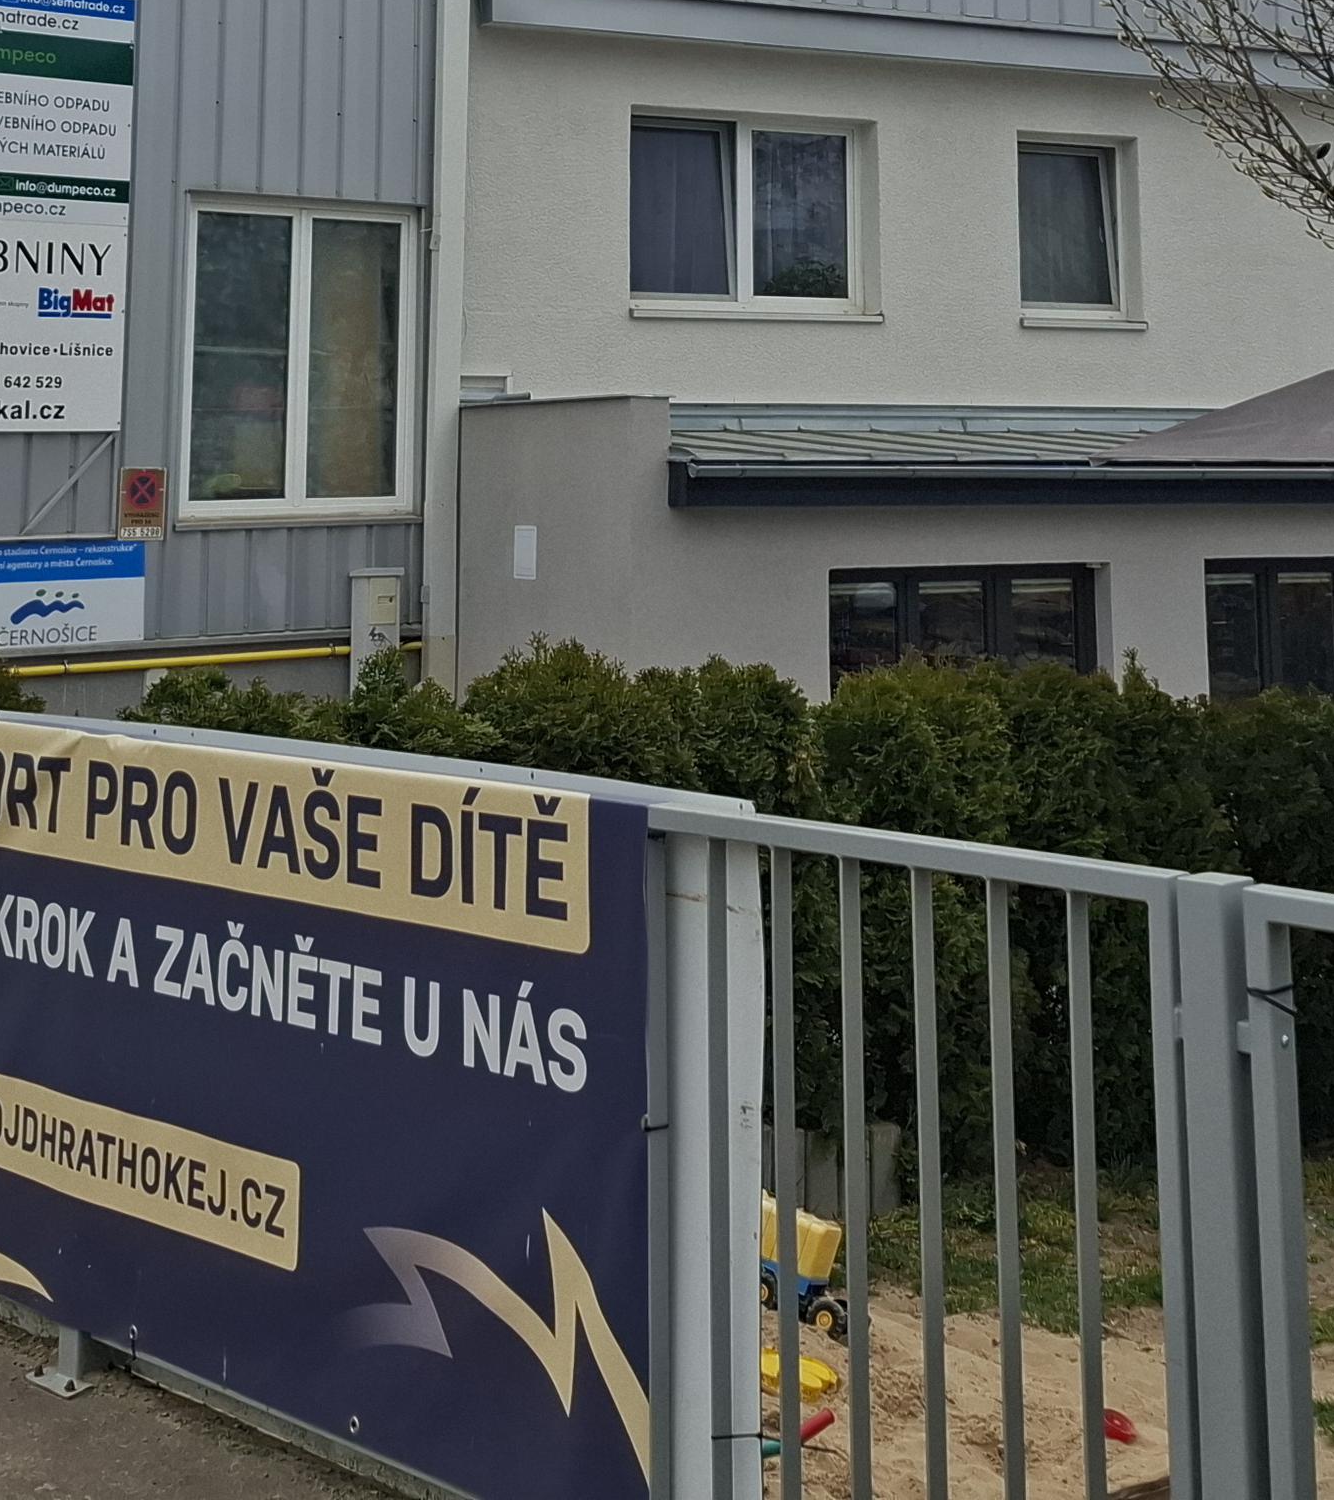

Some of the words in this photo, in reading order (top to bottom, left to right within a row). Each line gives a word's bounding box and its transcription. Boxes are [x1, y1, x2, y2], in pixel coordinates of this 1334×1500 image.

[54, 96, 110, 112] ODPADU
[60, 121, 117, 137] ODPADU
[33, 141, 106, 160] MATERIÁLŮ
[15, 179, 116, 197] info@dumpeco.cz
[38, 287, 115, 317] BigMat
[3, 375, 30, 389] 642
[36, 376, 62, 389] 529
[4, 546, 38, 556] stadionu
[39, 546, 77, 555] Černošice
[7, 559, 45, 571] agentury
[51, 558, 74, 567] města
[85, 759, 199, 855] PRO
[219, 766, 383, 889] VAŠE
[409, 785, 570, 922] DÍTĚ
[106, 927, 140, 988] A
[152, 920, 383, 1044] ZAČNĚTE
[403, 977, 441, 1058] U
[461, 980, 590, 1094] NÁS
